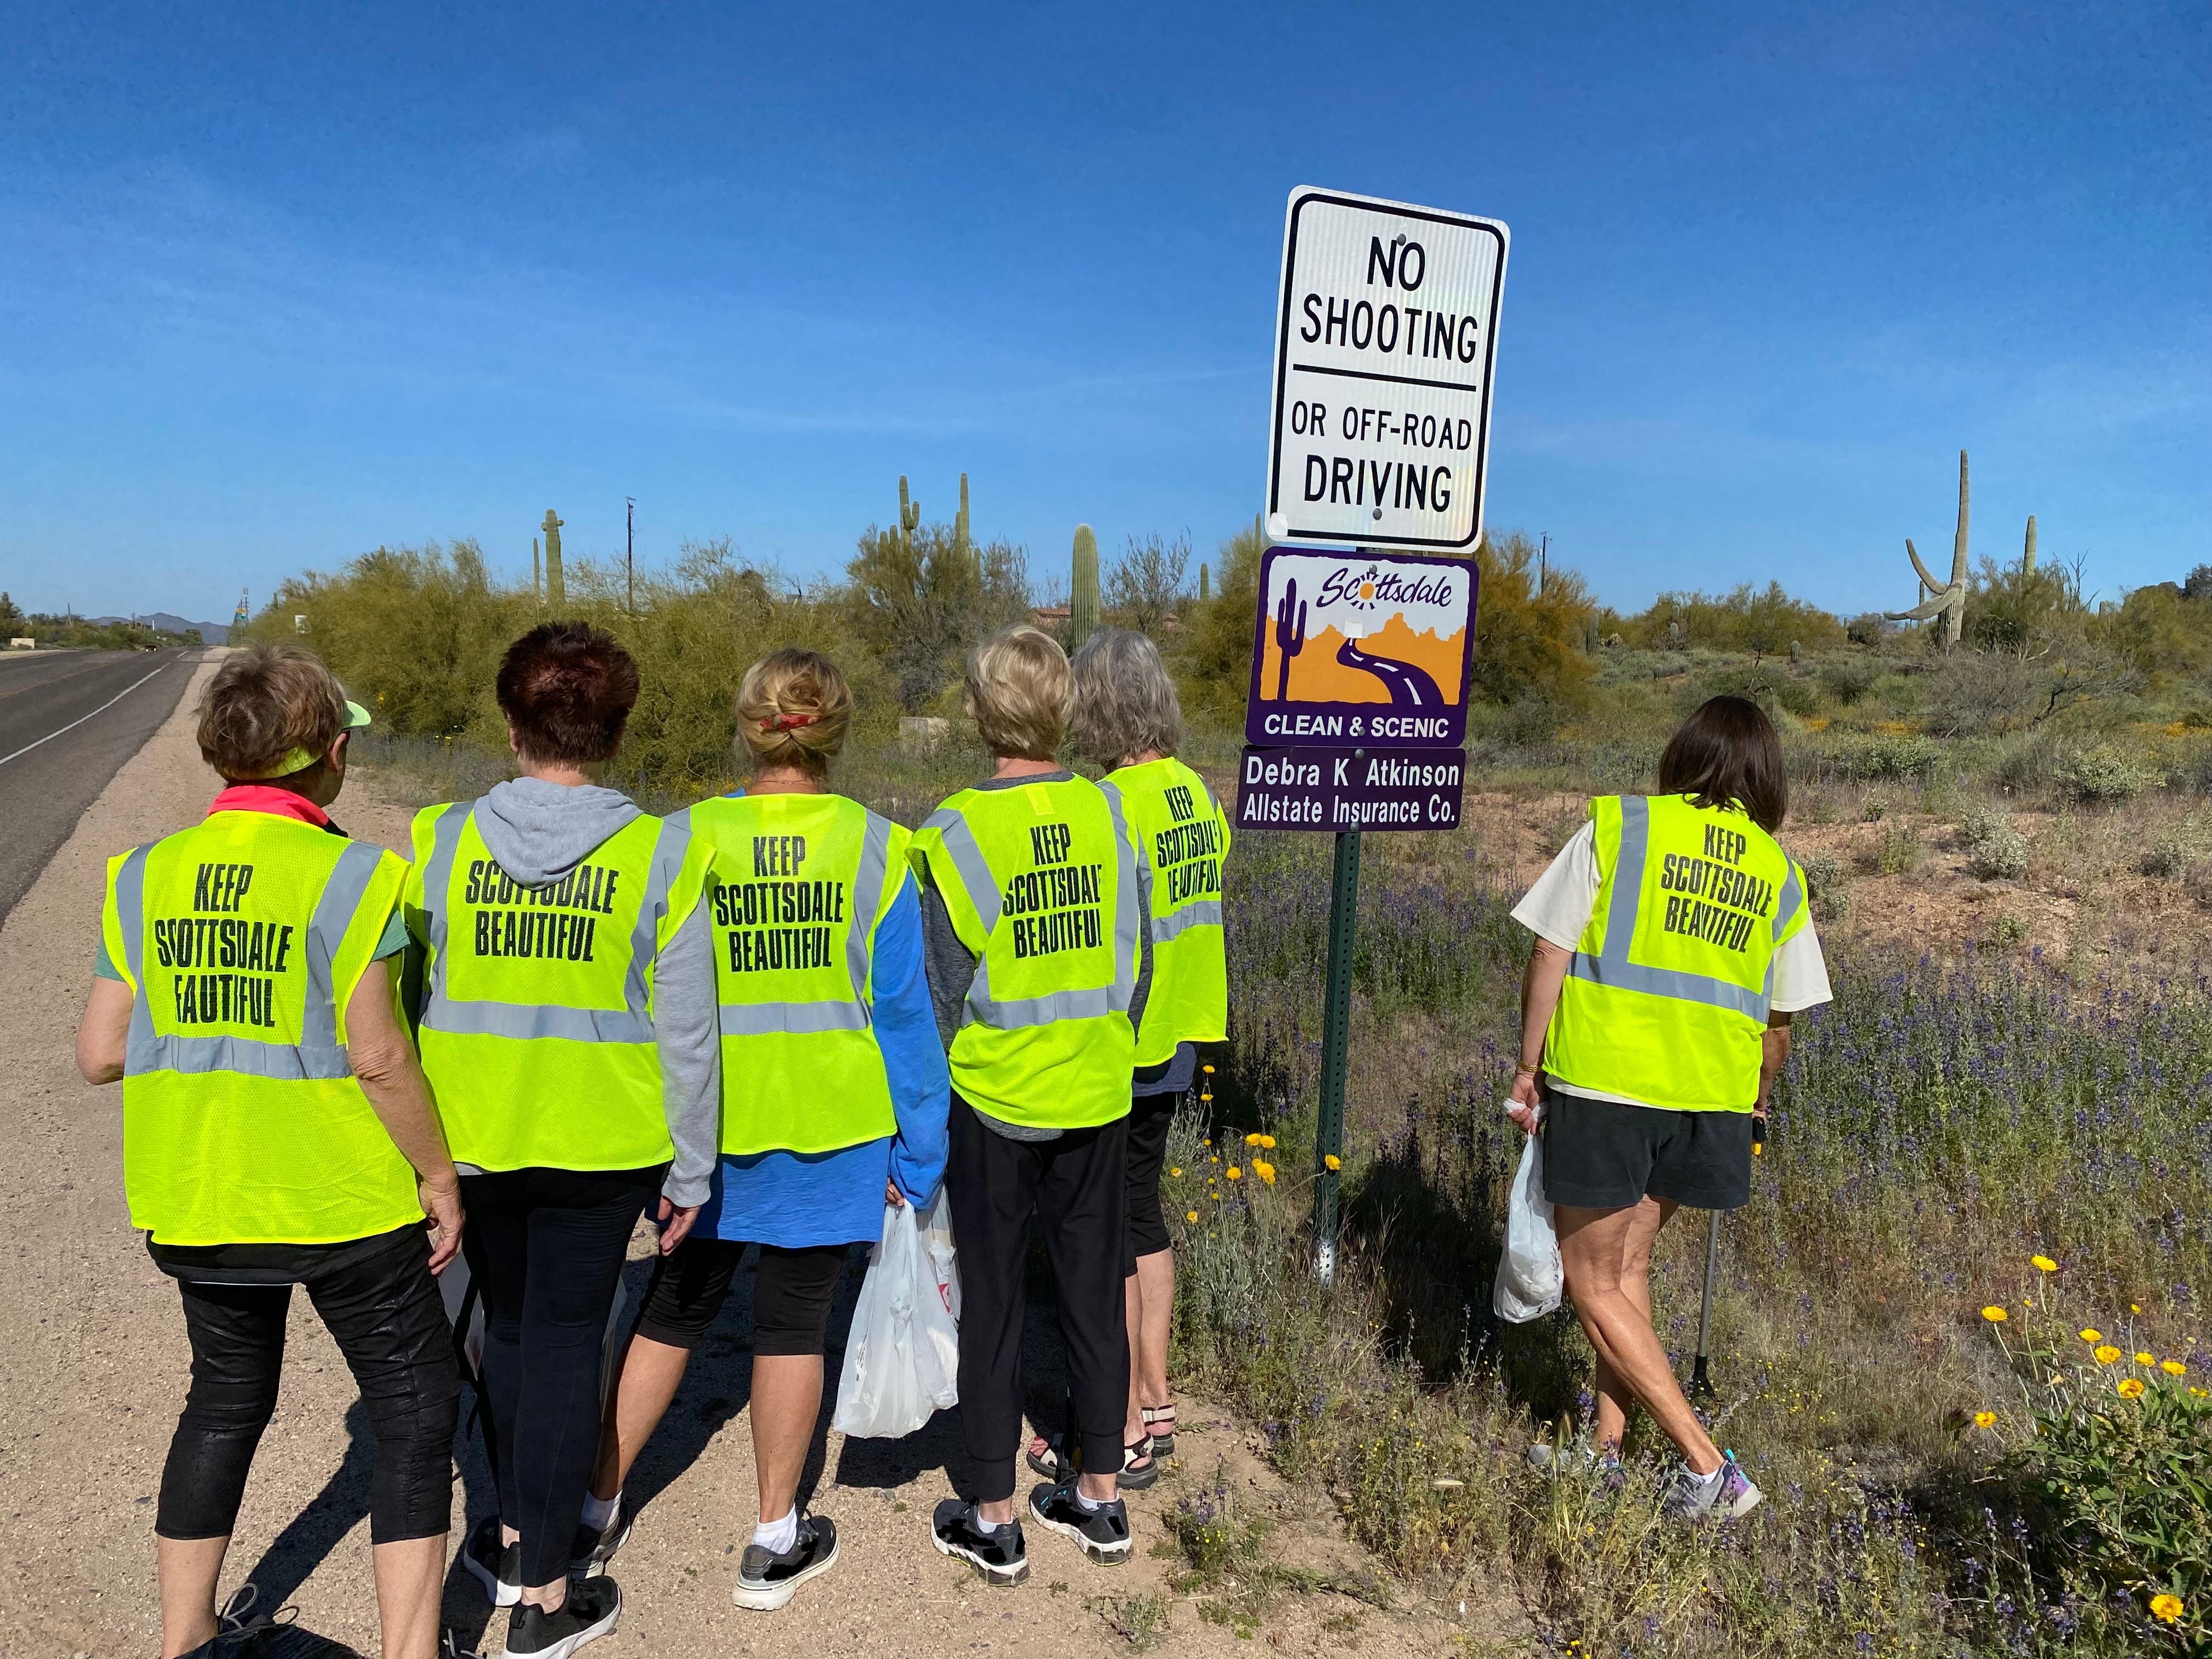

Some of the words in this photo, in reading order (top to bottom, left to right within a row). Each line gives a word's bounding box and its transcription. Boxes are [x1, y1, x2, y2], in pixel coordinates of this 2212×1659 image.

[1367, 236, 1425, 291] NO
[1301, 294, 1477, 363] SHOOTING
[1291, 400, 1326, 437] OR
[1342, 407, 1471, 450] OFF-ROAD
[1304, 454, 1452, 512] DRIVING
[1317, 567, 1452, 608] Scottsdale
[1265, 714, 1343, 736] CLEAN
[1349, 716, 1362, 736] &
[1370, 718, 1449, 738] SCENIC
[1246, 756, 1319, 786] Debra
[1334, 759, 1350, 786] K
[1365, 758, 1459, 786] Atkinson
[1164, 785, 1195, 822] KEEP
[1243, 793, 1323, 822] Allstate
[1333, 795, 1420, 823] Insurance
[1429, 794, 1455, 822] Co.
[753, 836, 805, 877] KEEP
[1030, 823, 1071, 866] KEEP
[1703, 823, 1746, 865] KEEP
[194, 864, 253, 912] KEEP
[714, 882, 843, 926] SCOTTSDALE
[1661, 853, 1773, 917] SCOTTSDALE
[475, 911, 595, 962] BEAUTIFUL
[729, 927, 832, 973] BEAUTIFUL
[1013, 909, 1103, 958] BEAUTIFUL
[174, 974, 275, 1027] EAUTIFUL
